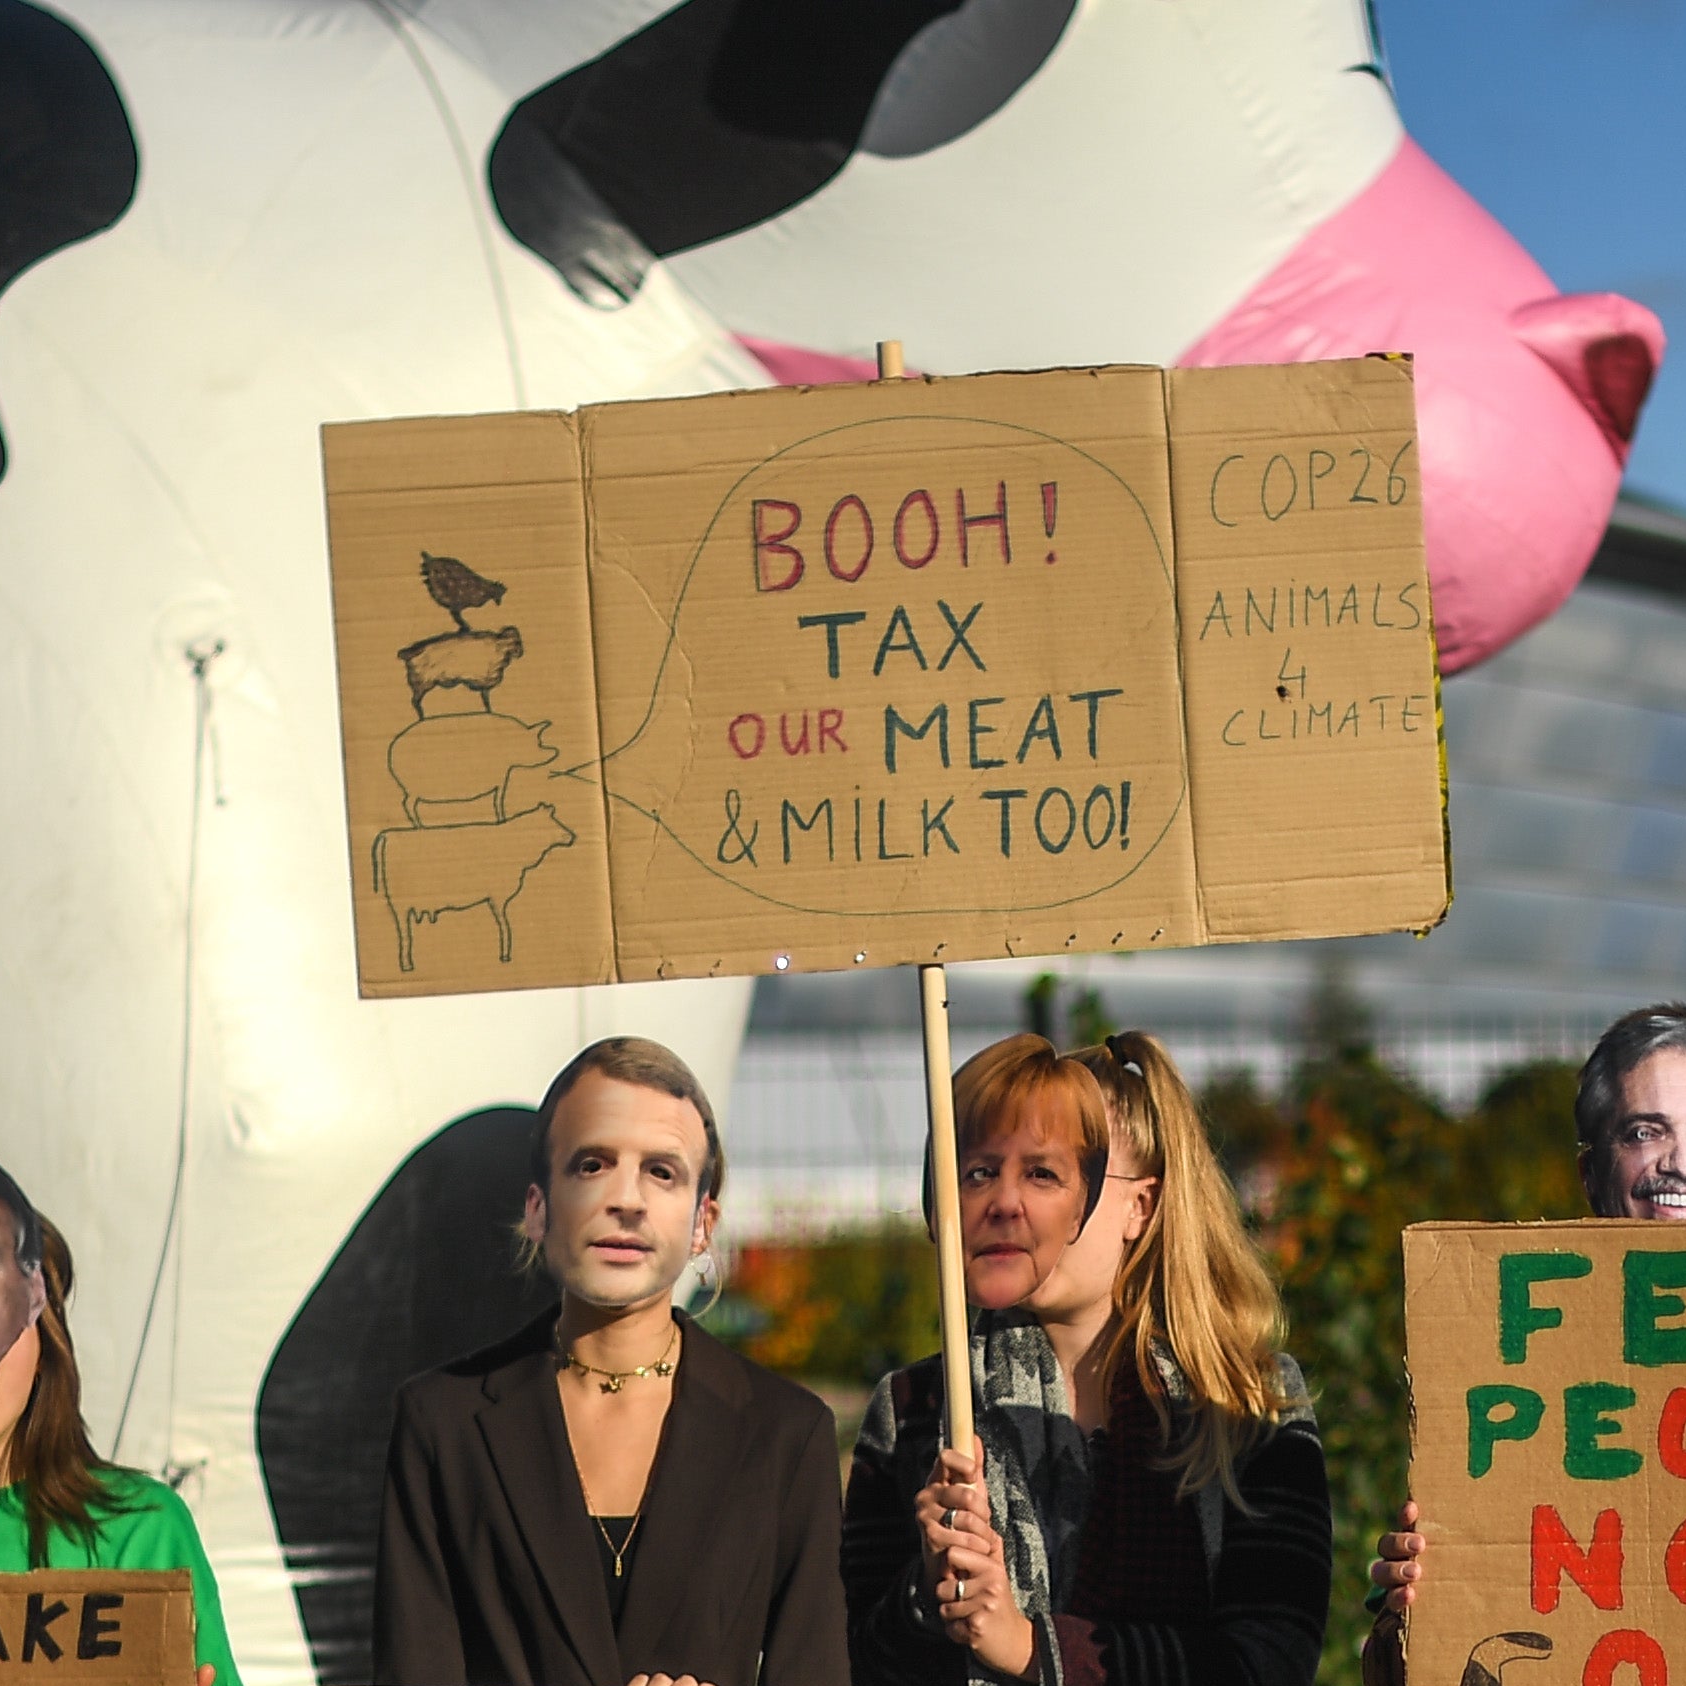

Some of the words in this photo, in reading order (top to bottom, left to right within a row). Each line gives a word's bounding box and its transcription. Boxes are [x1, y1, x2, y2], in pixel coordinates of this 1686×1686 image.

[798, 602, 987, 679] TAX
[1277, 646, 1307, 700] 4
[728, 706, 848, 762] OUR
[882, 688, 1125, 775] MEAT
[1222, 695, 1429, 746] CLIMATE
[716, 788, 759, 868] &
[981, 780, 1132, 859] TOO!
